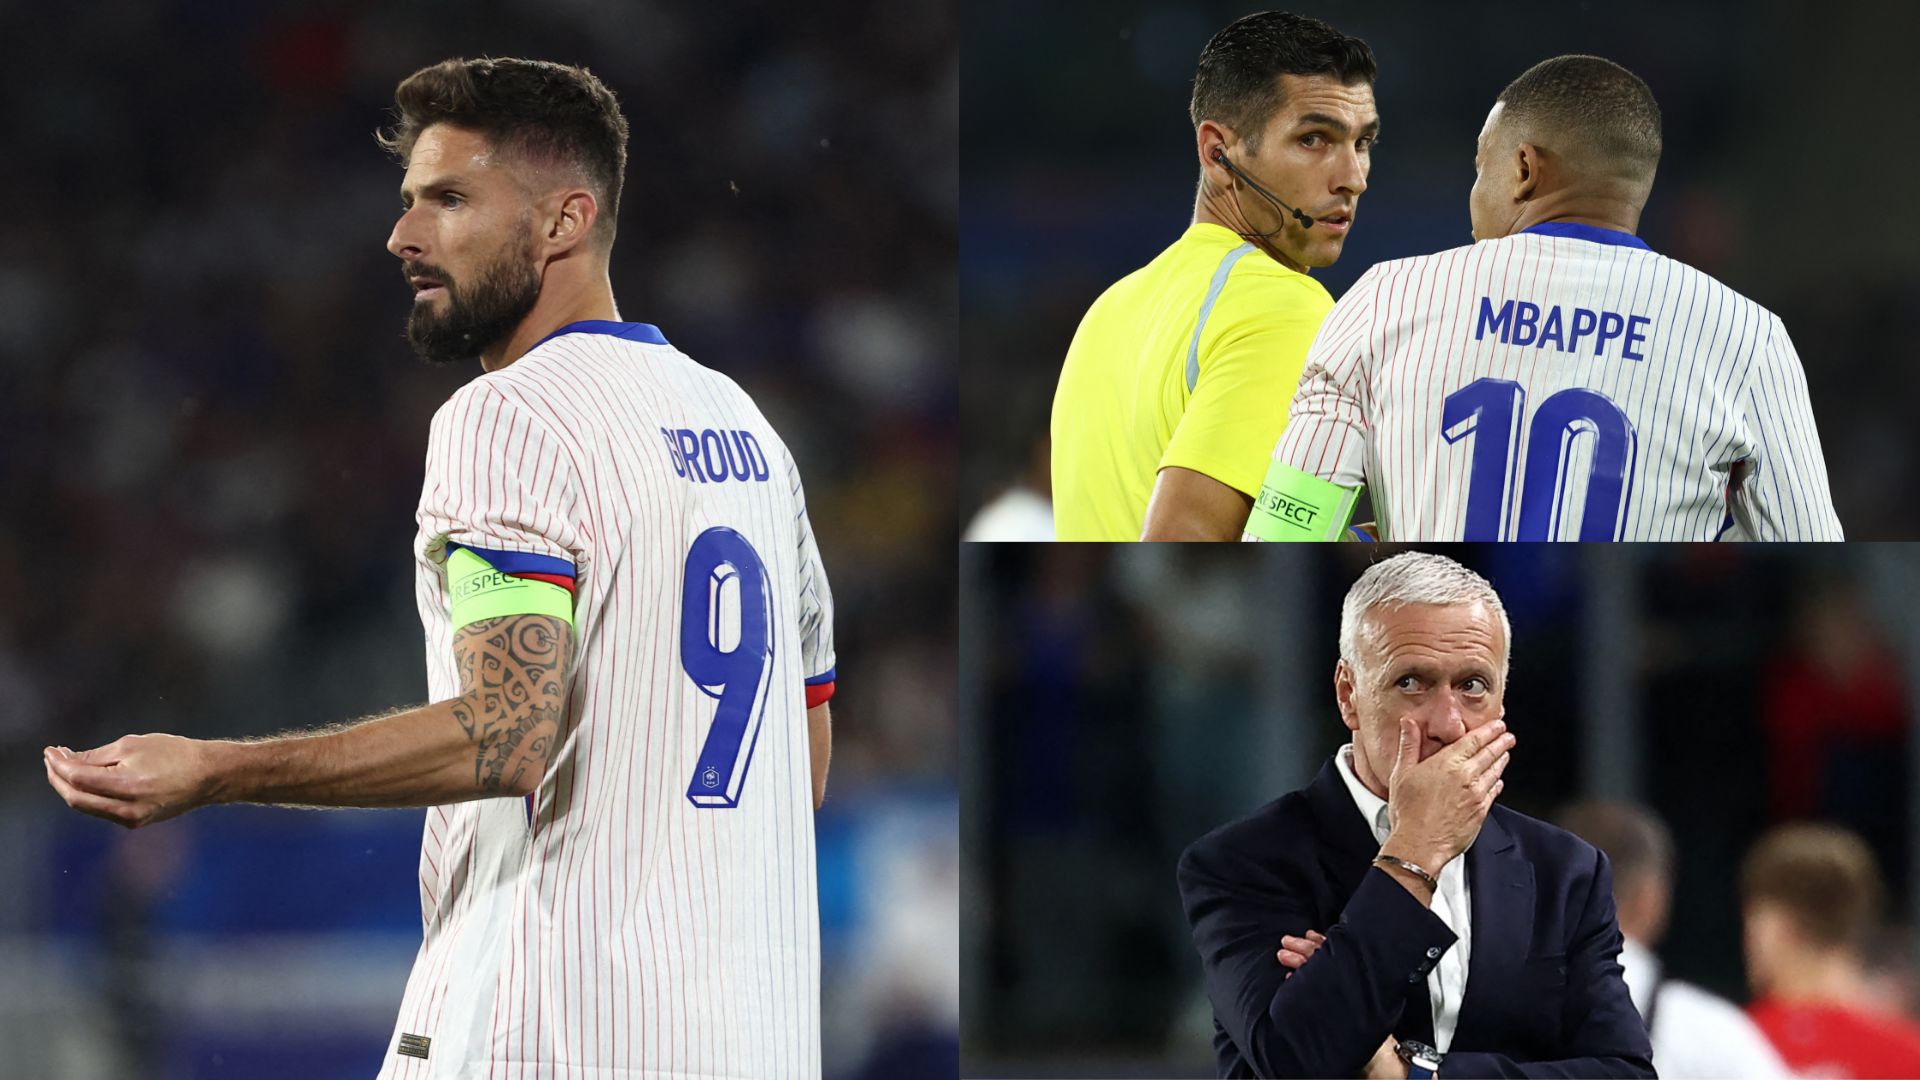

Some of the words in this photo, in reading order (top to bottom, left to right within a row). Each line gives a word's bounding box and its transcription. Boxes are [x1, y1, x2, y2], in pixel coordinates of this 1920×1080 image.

[1475, 296, 1651, 361] MBAPPE
[660, 427, 769, 483] GIROUD
[1441, 377, 1637, 542] 10
[455, 572, 523, 600] RESPEC
[680, 526, 775, 808] 9
